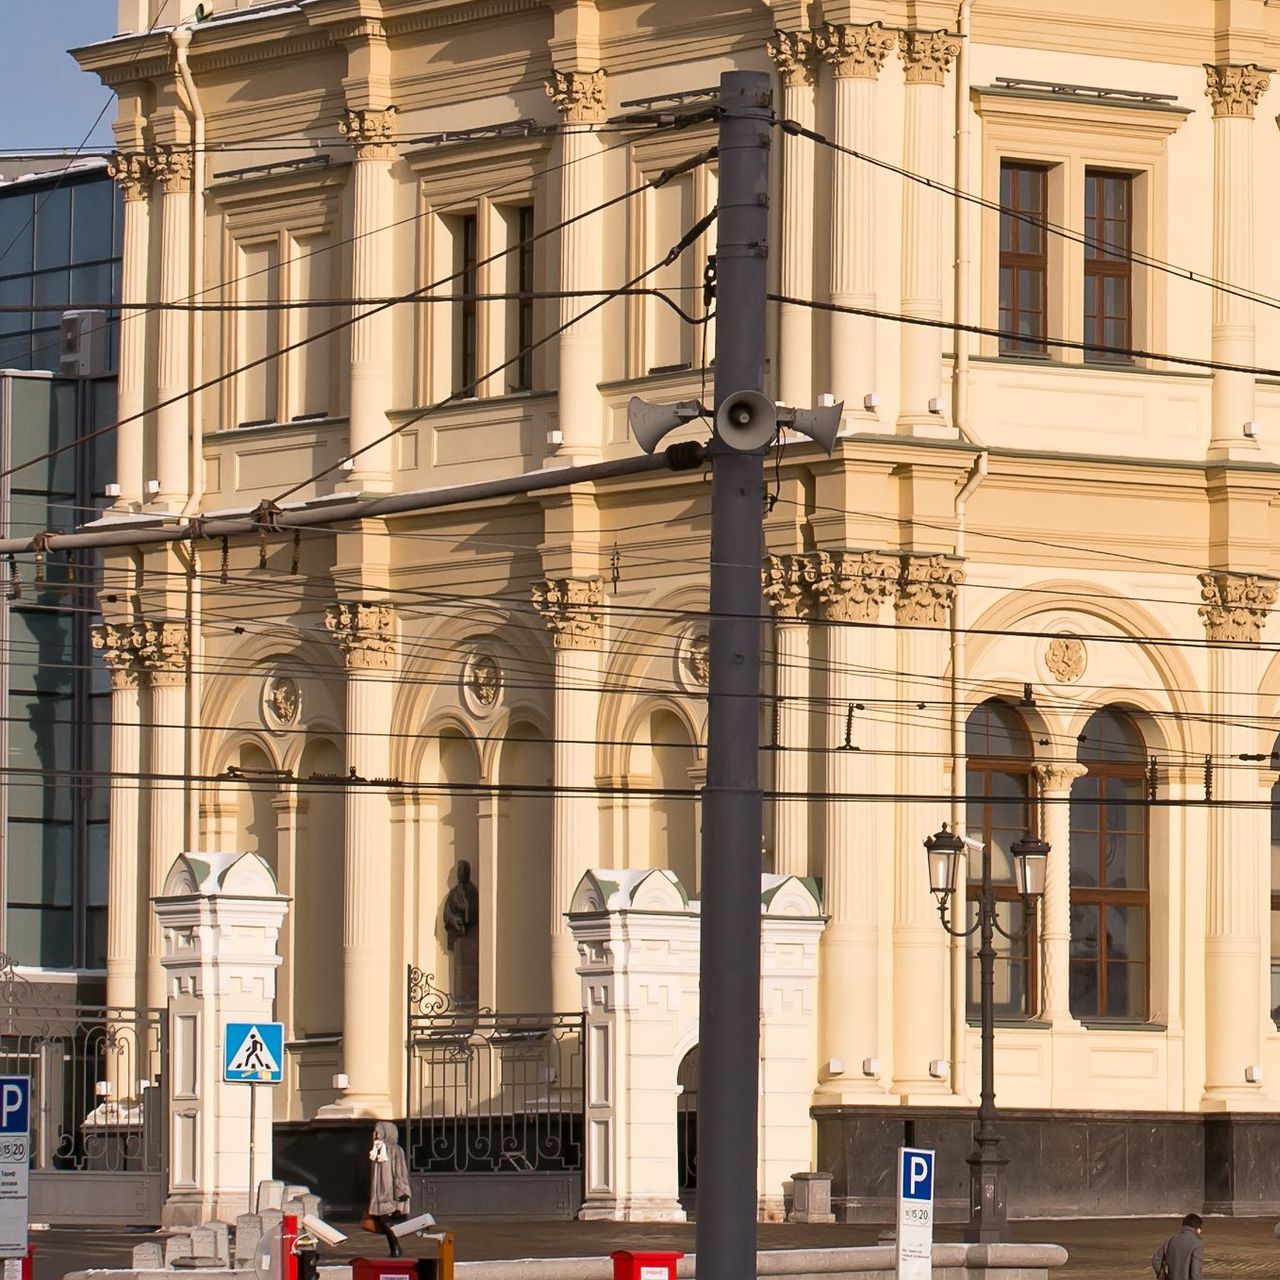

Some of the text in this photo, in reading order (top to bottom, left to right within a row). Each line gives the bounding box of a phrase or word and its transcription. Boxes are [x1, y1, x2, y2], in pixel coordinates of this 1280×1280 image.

[1, 1084, 23, 1128] P
[13, 1144, 24, 1156] 20
[910, 1156, 928, 1195] P
[919, 1209, 929, 1220] 20
